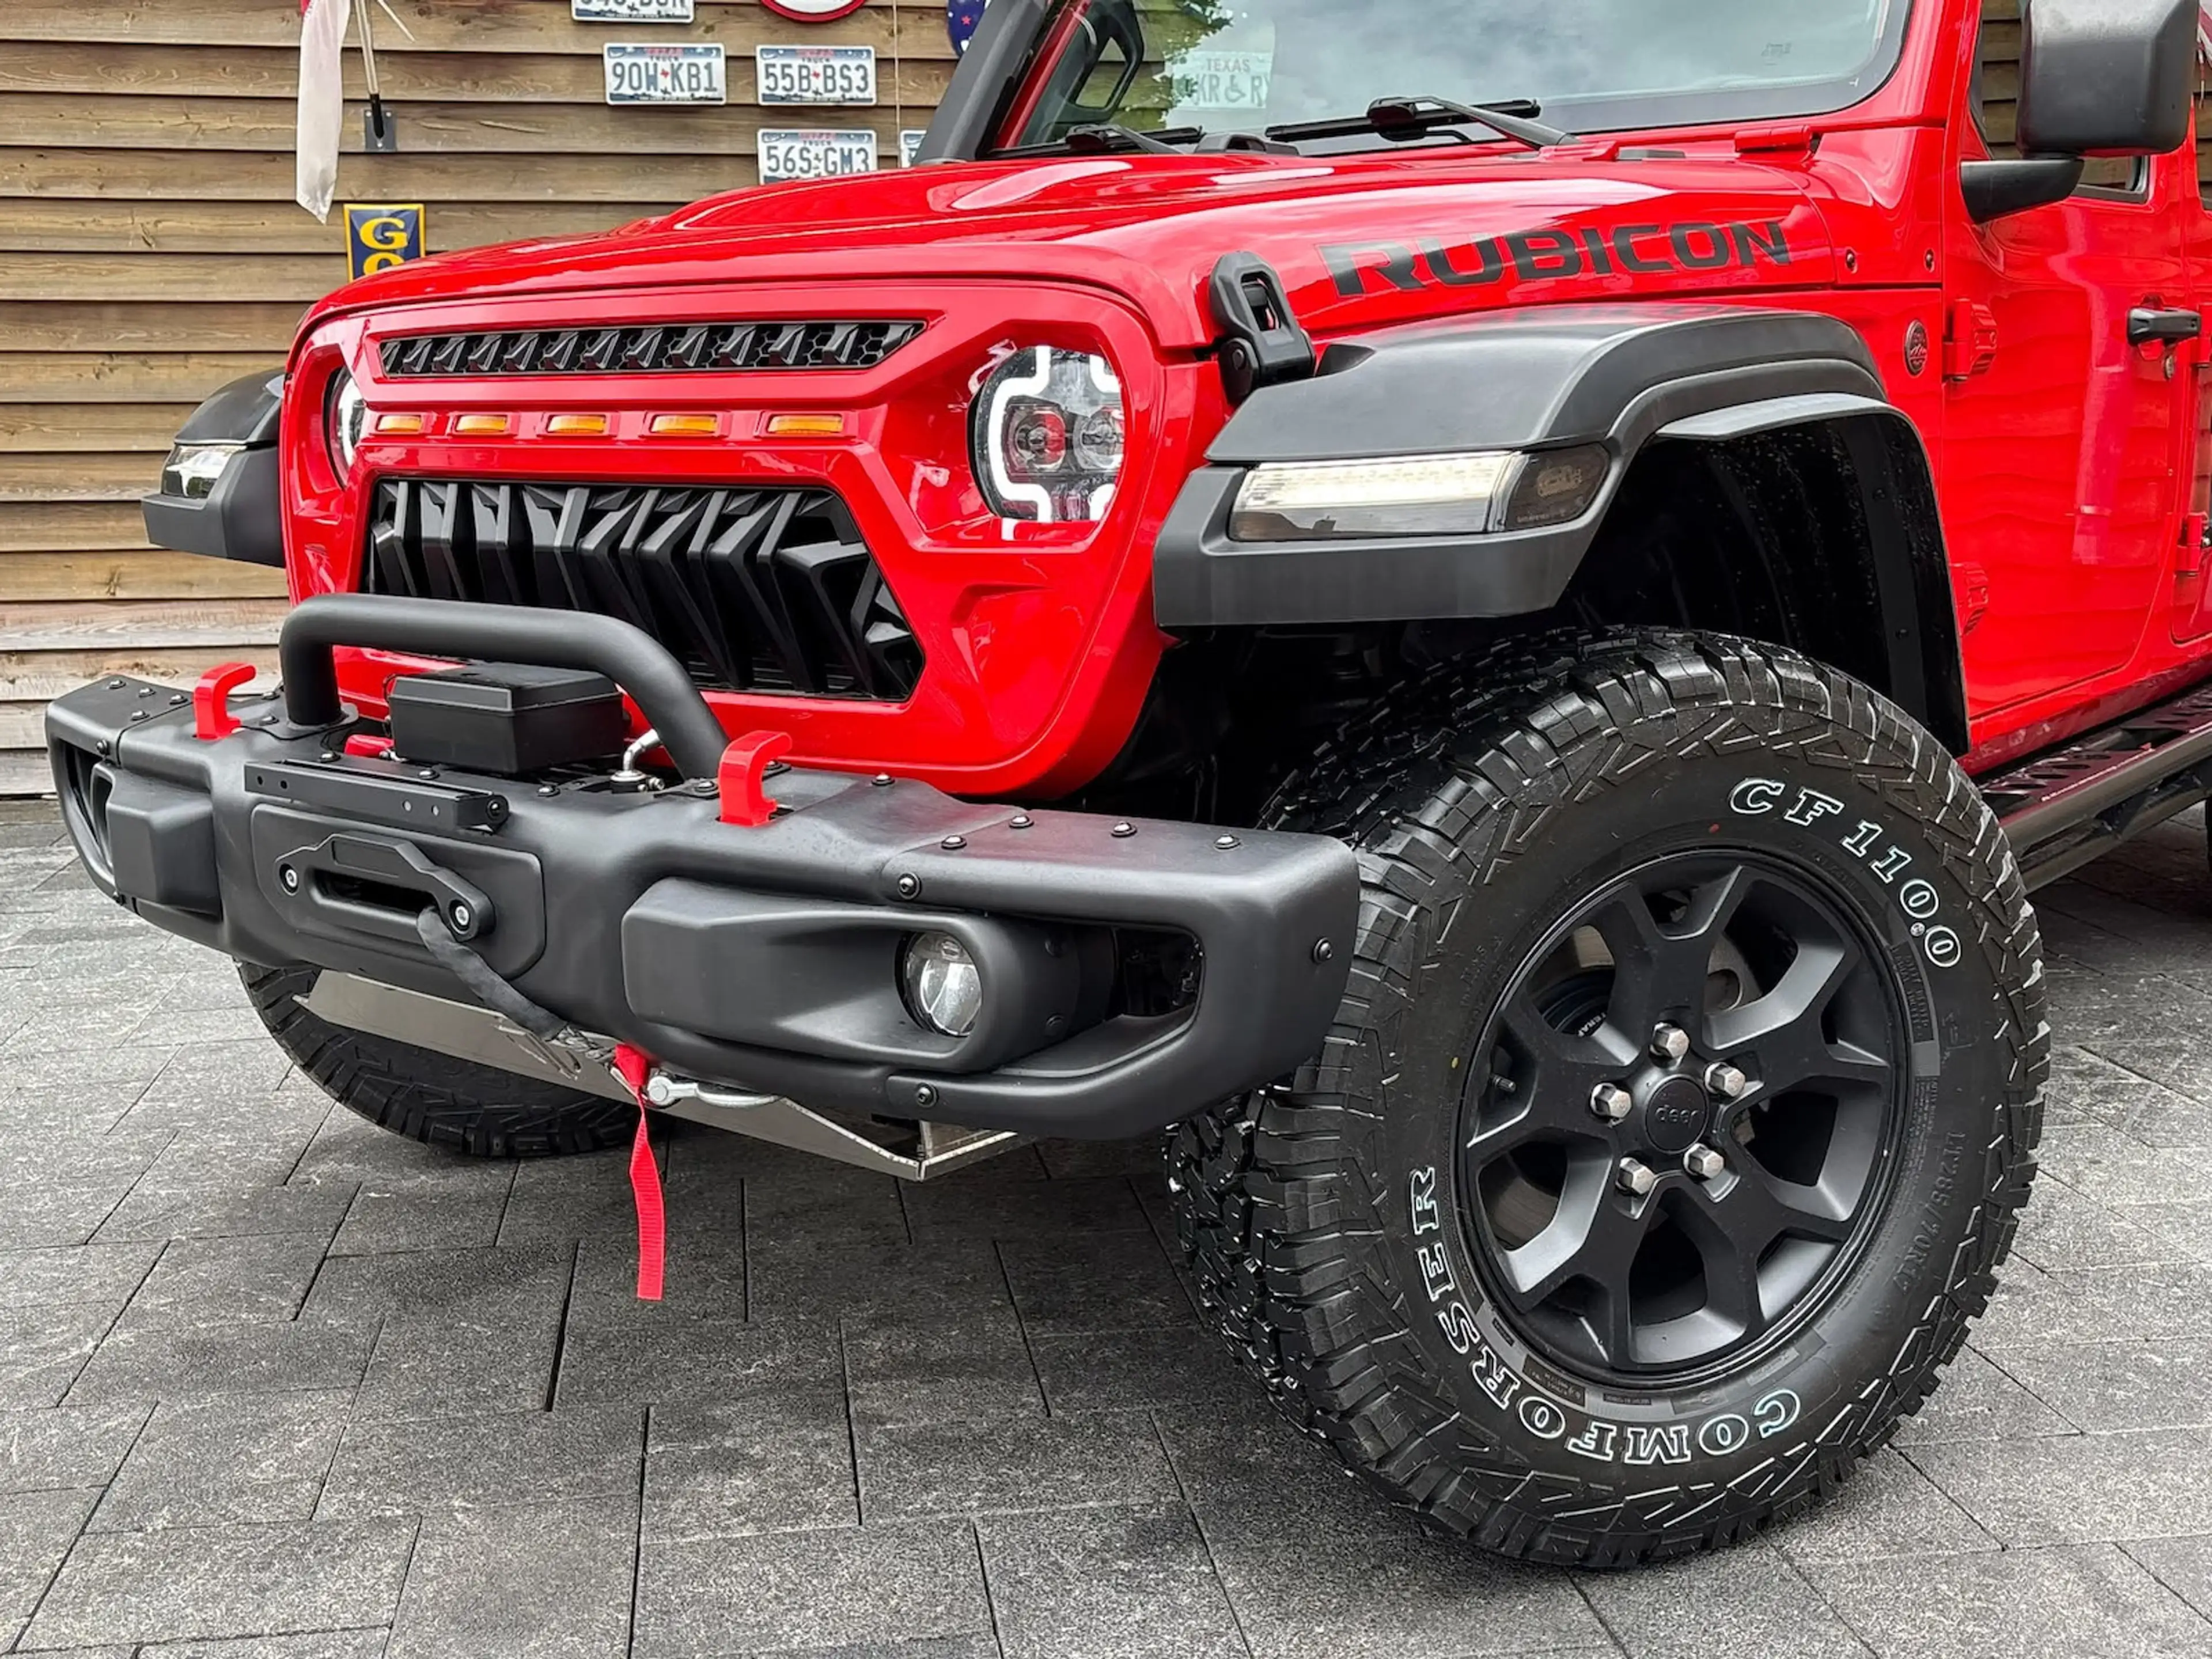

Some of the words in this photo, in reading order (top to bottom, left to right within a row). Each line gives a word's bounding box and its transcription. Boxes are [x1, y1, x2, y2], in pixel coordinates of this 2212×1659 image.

[1206, 58, 1251, 73] TEXAS
[1318, 221, 1791, 297] RUBICON
[1729, 777, 1844, 826] CF
[1410, 1166, 1801, 1465] COMFORSER
